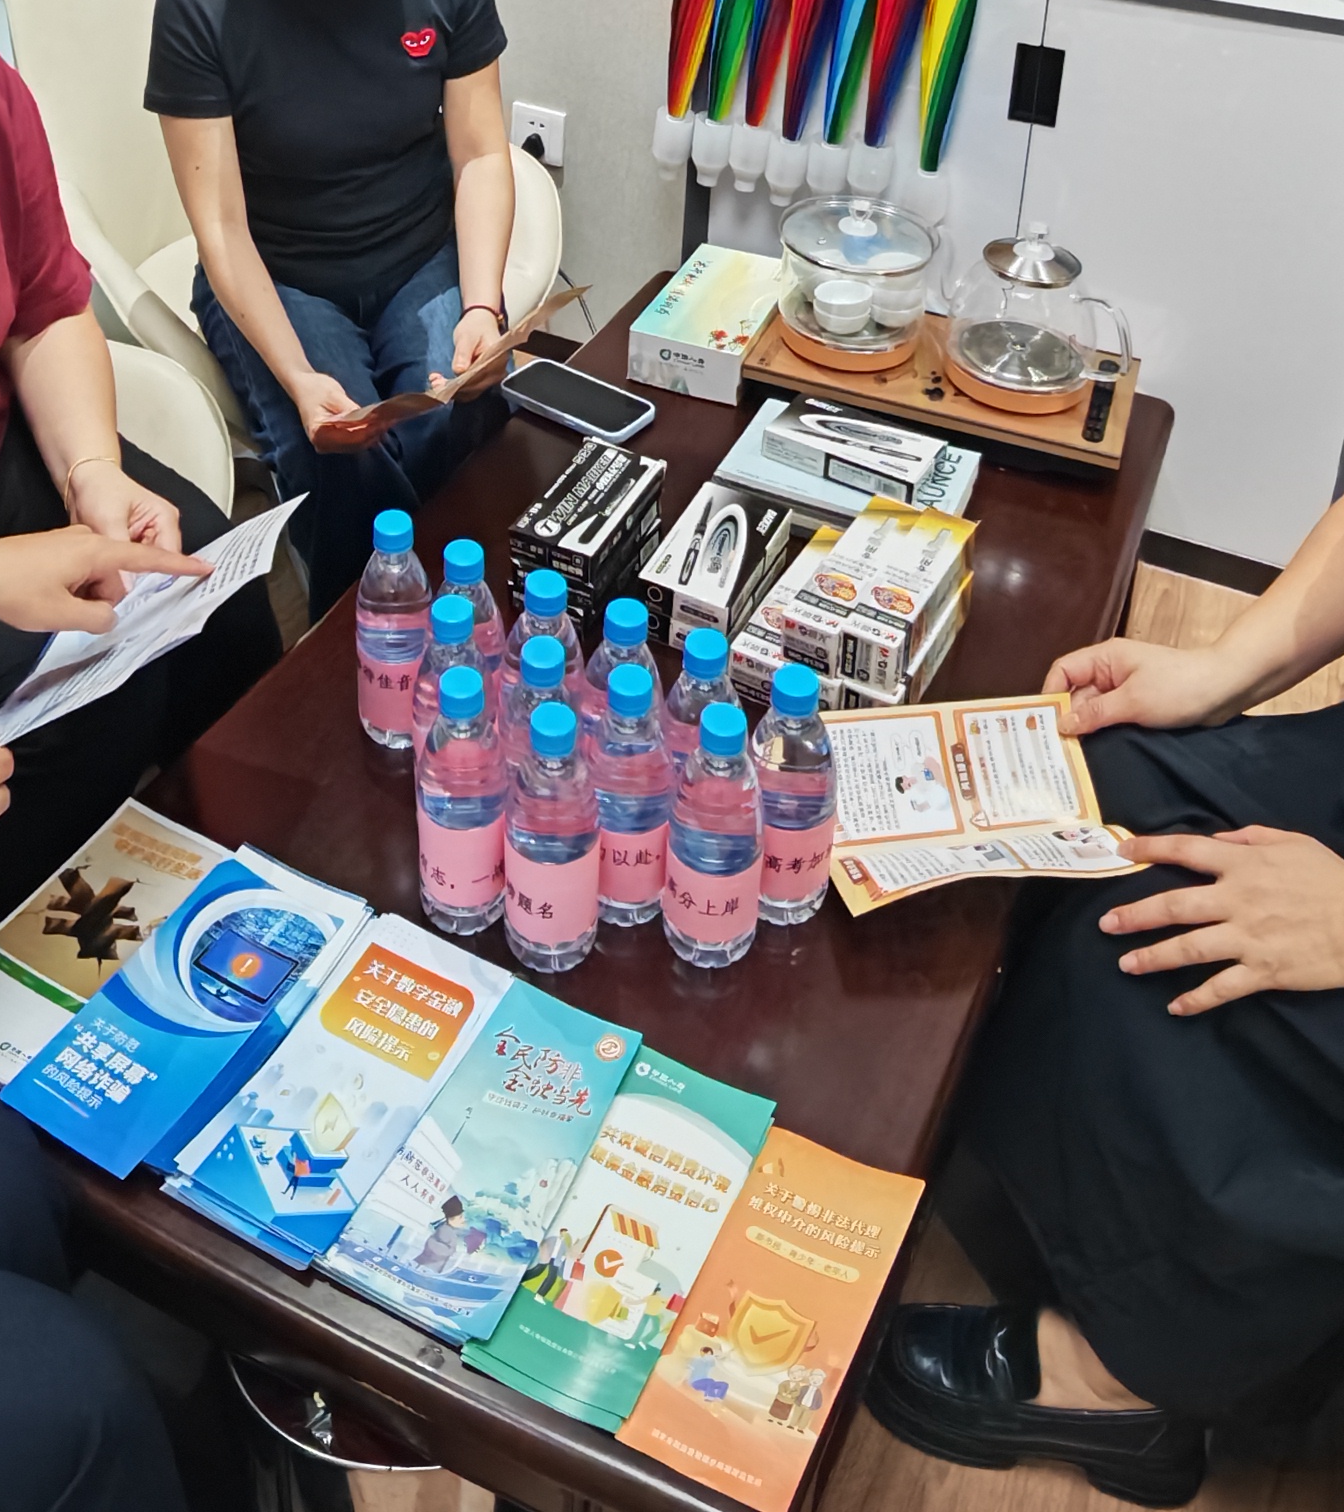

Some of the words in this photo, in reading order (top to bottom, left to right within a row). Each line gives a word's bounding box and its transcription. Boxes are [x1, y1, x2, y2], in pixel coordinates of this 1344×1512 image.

[534, 489, 578, 537] TWIN
[353, 989, 441, 1041] 安全隐患的
[363, 958, 464, 1019] 关于数字金融
[344, 1017, 415, 1062] 风险提示
[494, 1025, 583, 1084] 全民防非
[42, 1064, 104, 1110] 的风险提示
[55, 1046, 133, 1105] 网络诈骗
[747, 1194, 882, 1260] 维权中介的风险提示
[763, 1181, 883, 1240] 关于警惕非法代理
